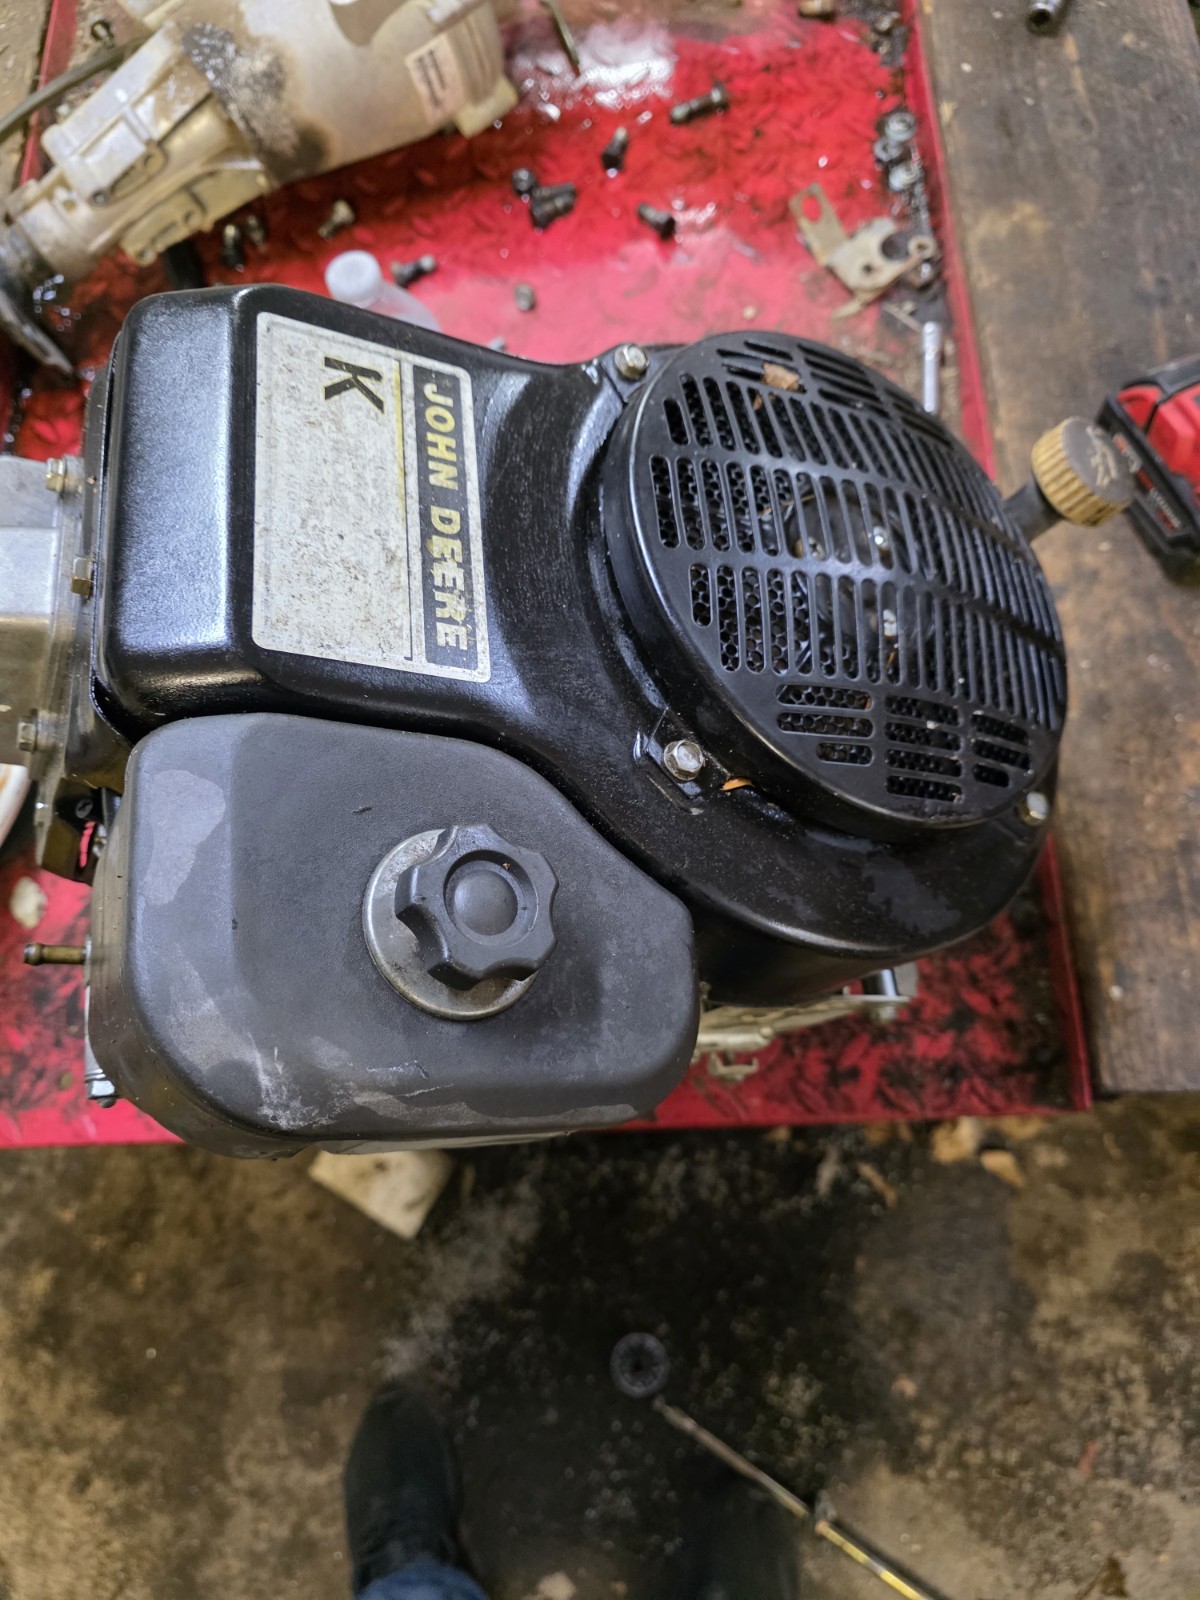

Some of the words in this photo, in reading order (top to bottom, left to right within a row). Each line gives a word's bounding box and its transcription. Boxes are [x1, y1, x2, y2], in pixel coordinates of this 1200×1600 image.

[323, 356, 385, 414] K
[423, 382, 459, 491] JOHN
[430, 504, 468, 651] DEERE
